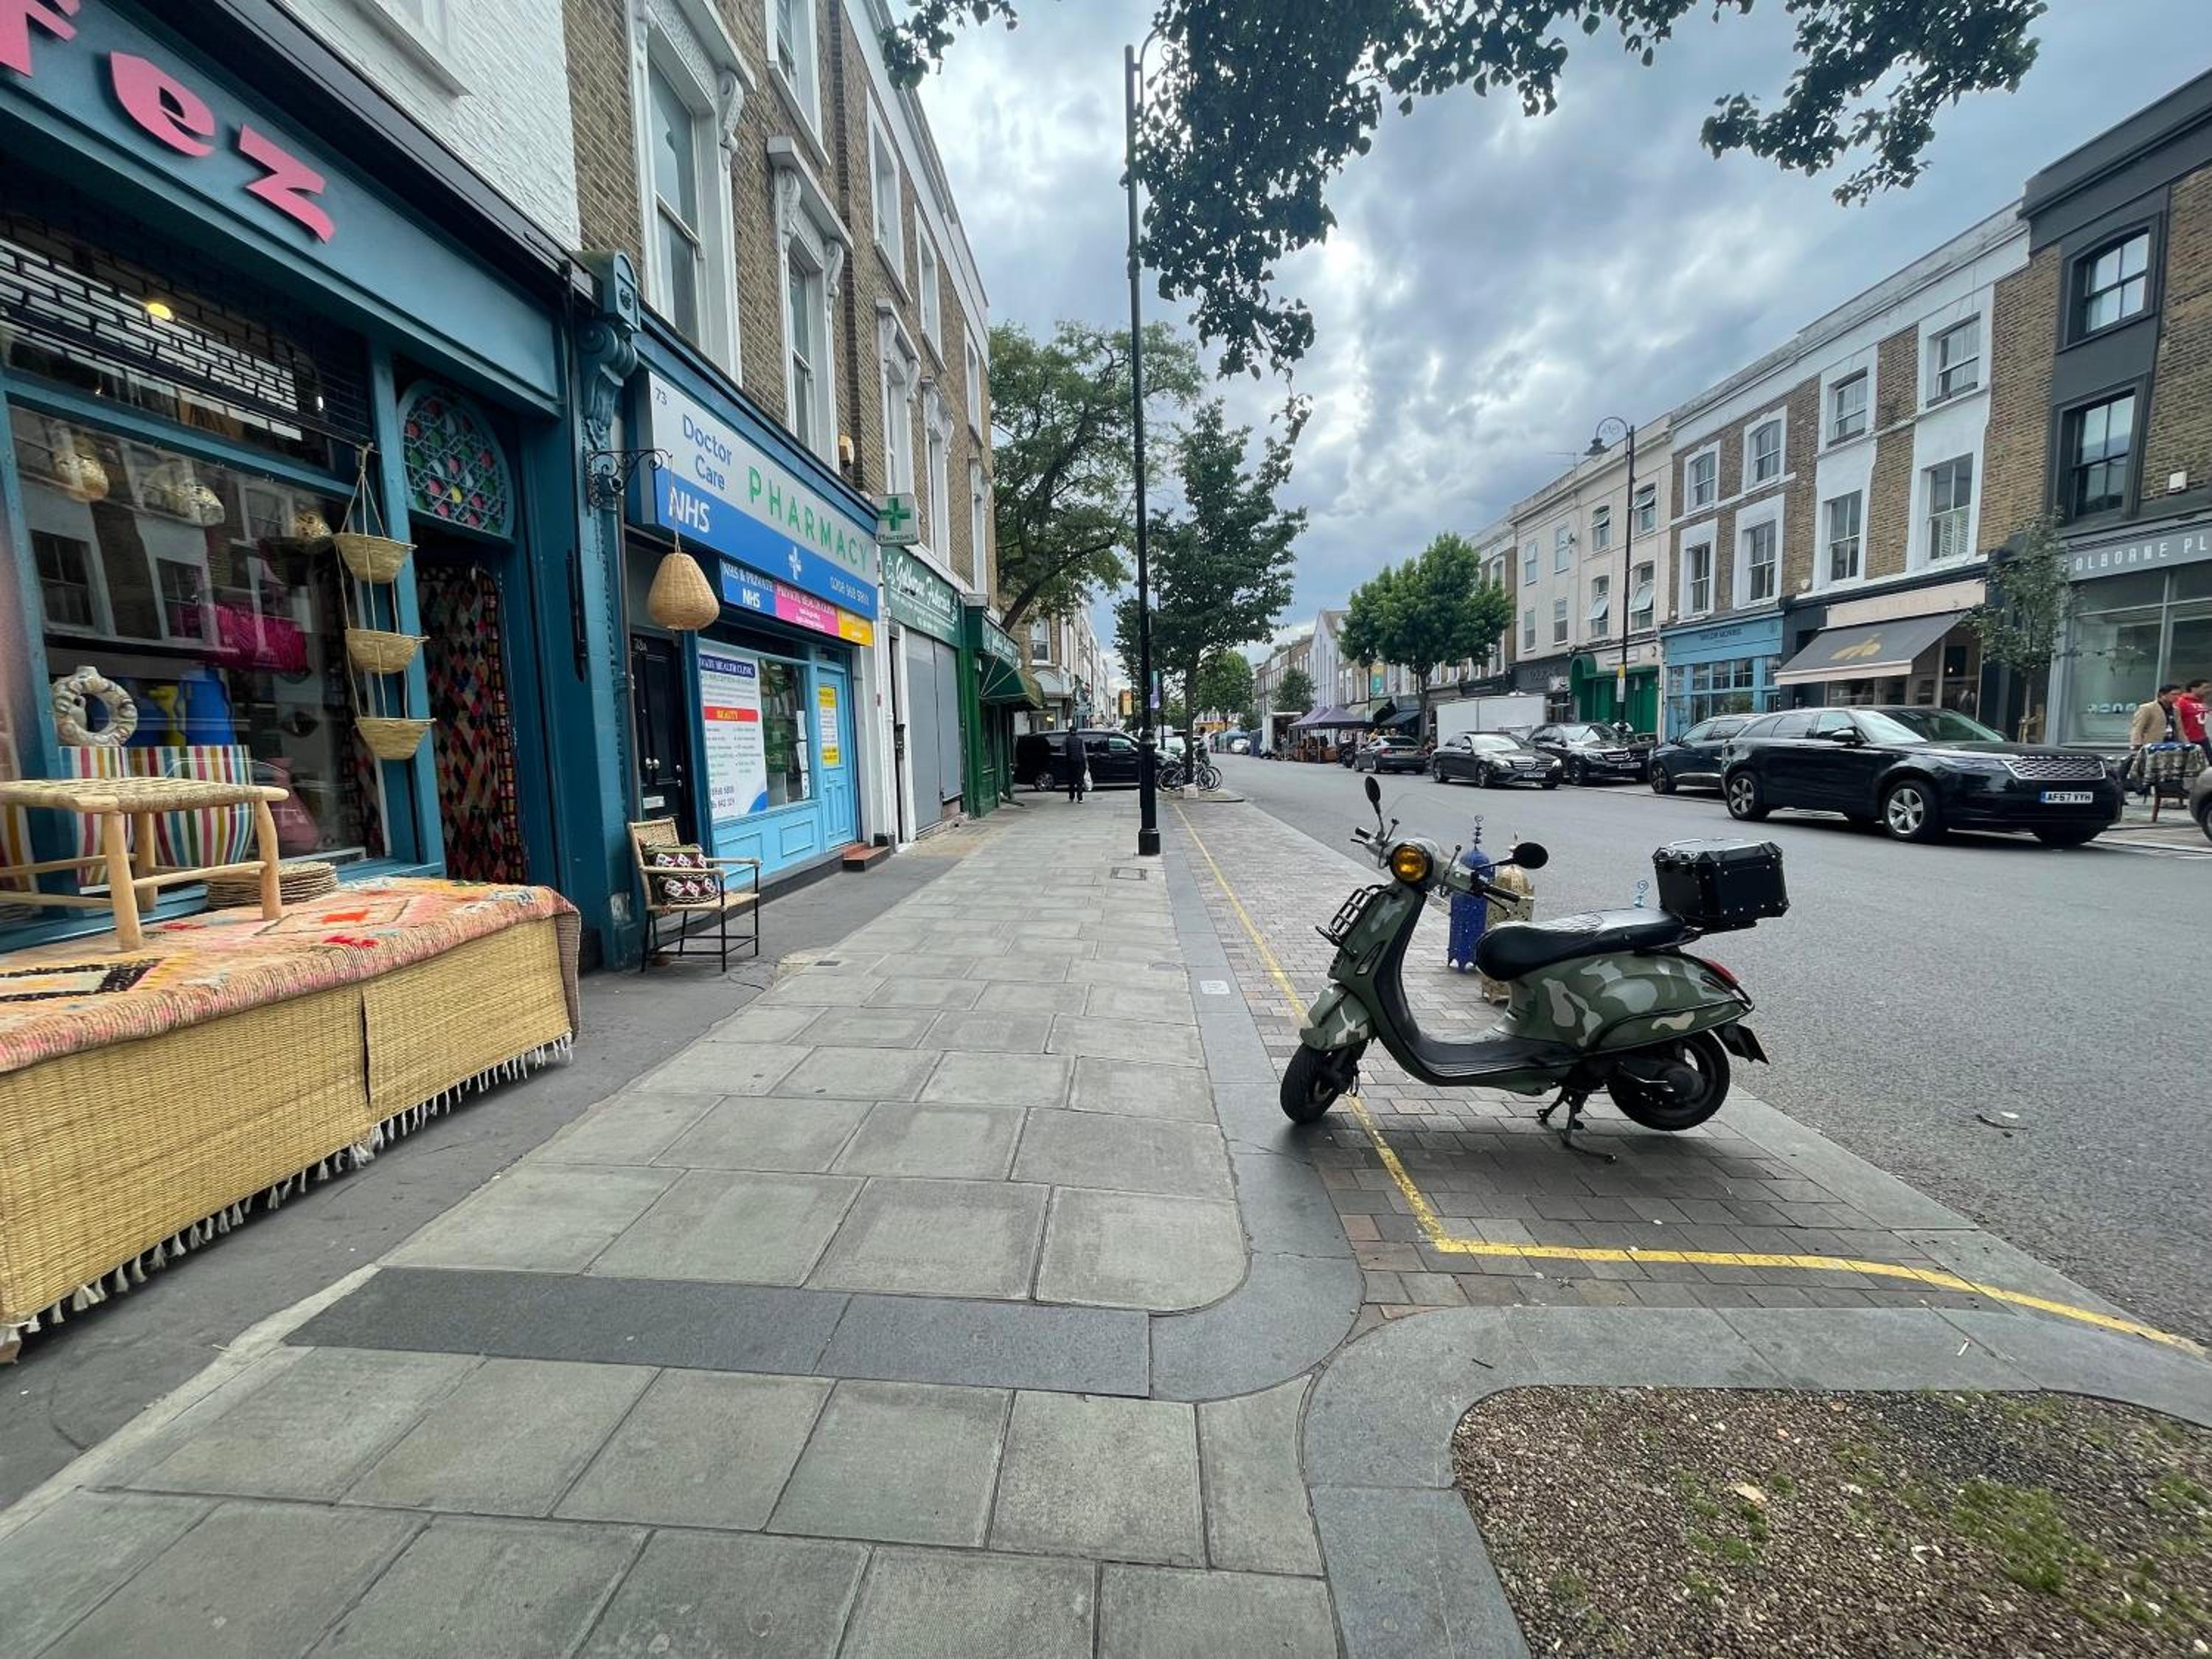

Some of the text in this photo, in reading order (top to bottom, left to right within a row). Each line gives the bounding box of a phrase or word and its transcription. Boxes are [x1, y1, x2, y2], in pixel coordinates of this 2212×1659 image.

[655, 388, 667, 406] 73
[683, 414, 732, 466] Doctor
[695, 456, 726, 491] Care
[669, 487, 710, 533] NHS
[748, 465, 868, 571] PHARMACY
[2063, 542, 2168, 573] OLBORNE
[742, 588, 760, 608] NHS
